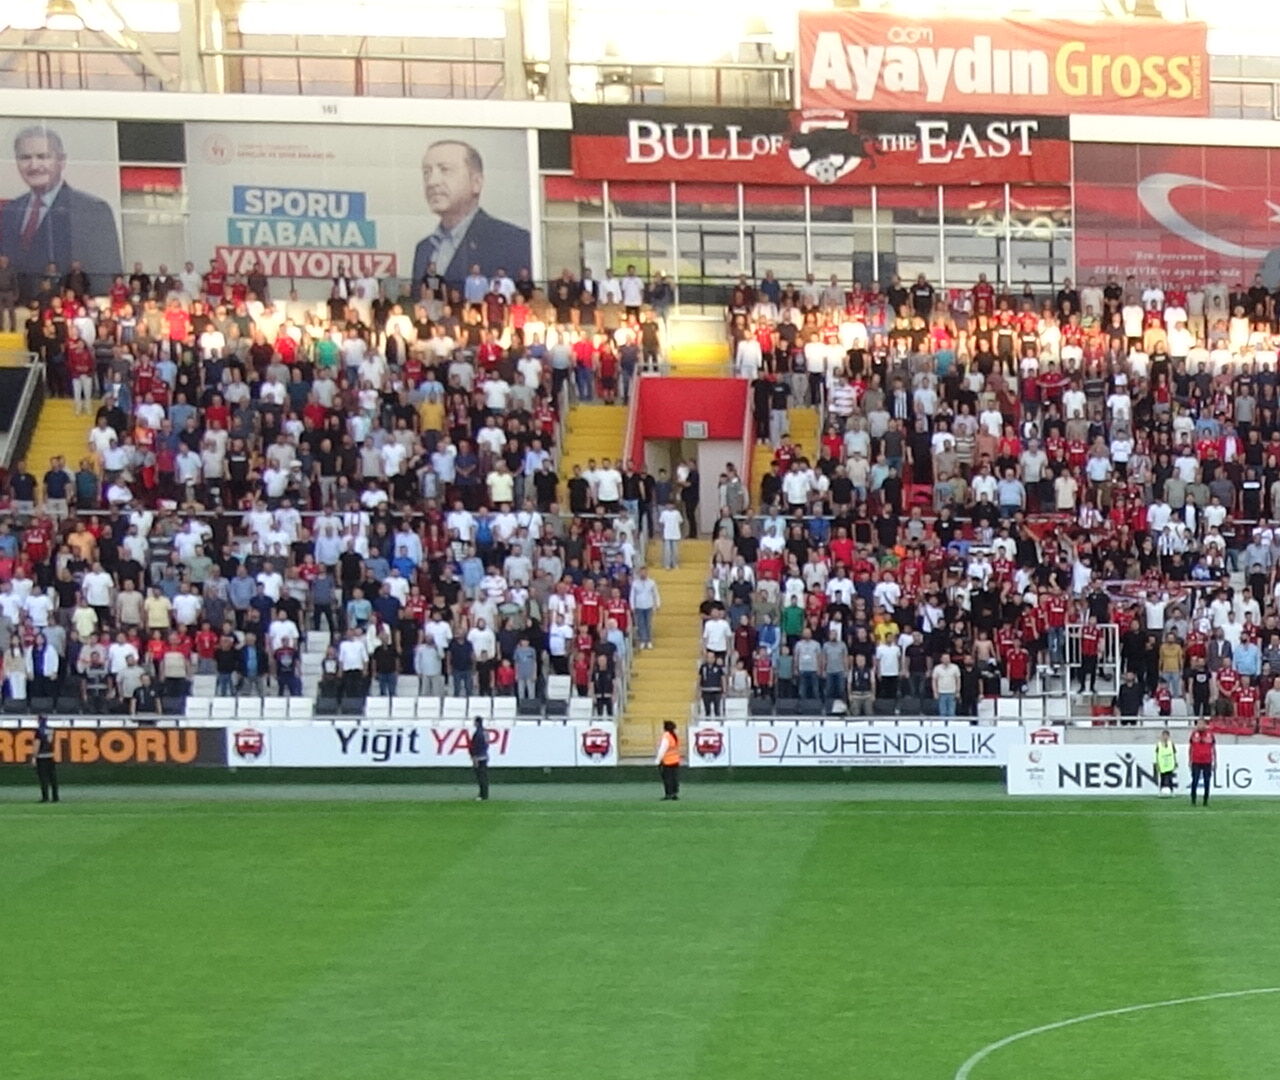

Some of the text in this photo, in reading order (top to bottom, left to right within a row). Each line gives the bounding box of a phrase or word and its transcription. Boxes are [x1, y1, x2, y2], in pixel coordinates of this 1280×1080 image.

[809, 31, 1049, 102] Ayaydın
[1055, 41, 1192, 98] Gross
[626, 119, 1039, 165] BULL OF THE EAST
[244, 188, 350, 219] SPORU
[236, 220, 365, 247] TABANA
[219, 248, 393, 279] YAYIYORUZ
[336, 727, 421, 762] Yiğit
